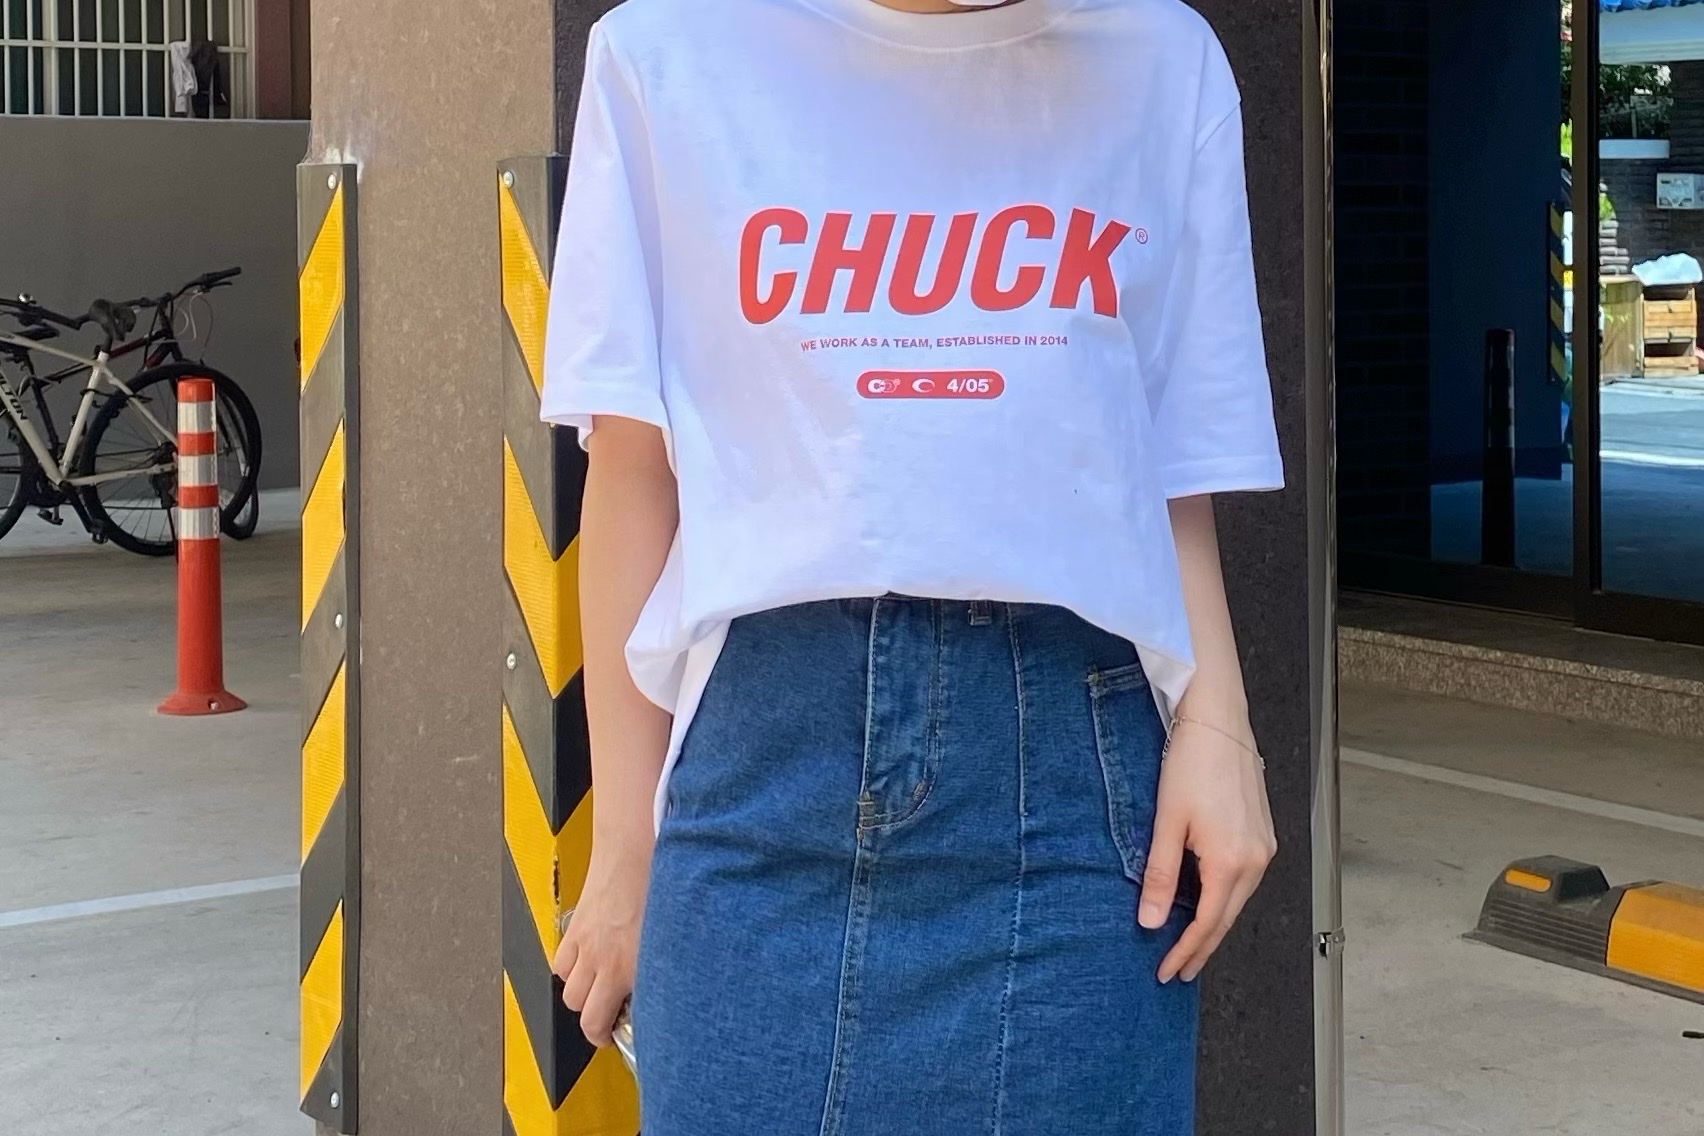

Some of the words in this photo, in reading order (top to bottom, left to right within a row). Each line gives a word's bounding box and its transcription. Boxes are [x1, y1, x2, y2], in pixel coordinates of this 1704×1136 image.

[739, 204, 1131, 325] CHUCK
[800, 340, 817, 352] WE
[820, 337, 857, 349] WORK
[861, 337, 877, 347] AS
[881, 338, 890, 348] A
[893, 338, 932, 349] TEAM,
[936, 335, 1021, 348] ESTABLISHED
[1024, 335, 1037, 346] IN
[1040, 335, 1068, 346] 2014
[946, 378, 990, 393] 4/05
